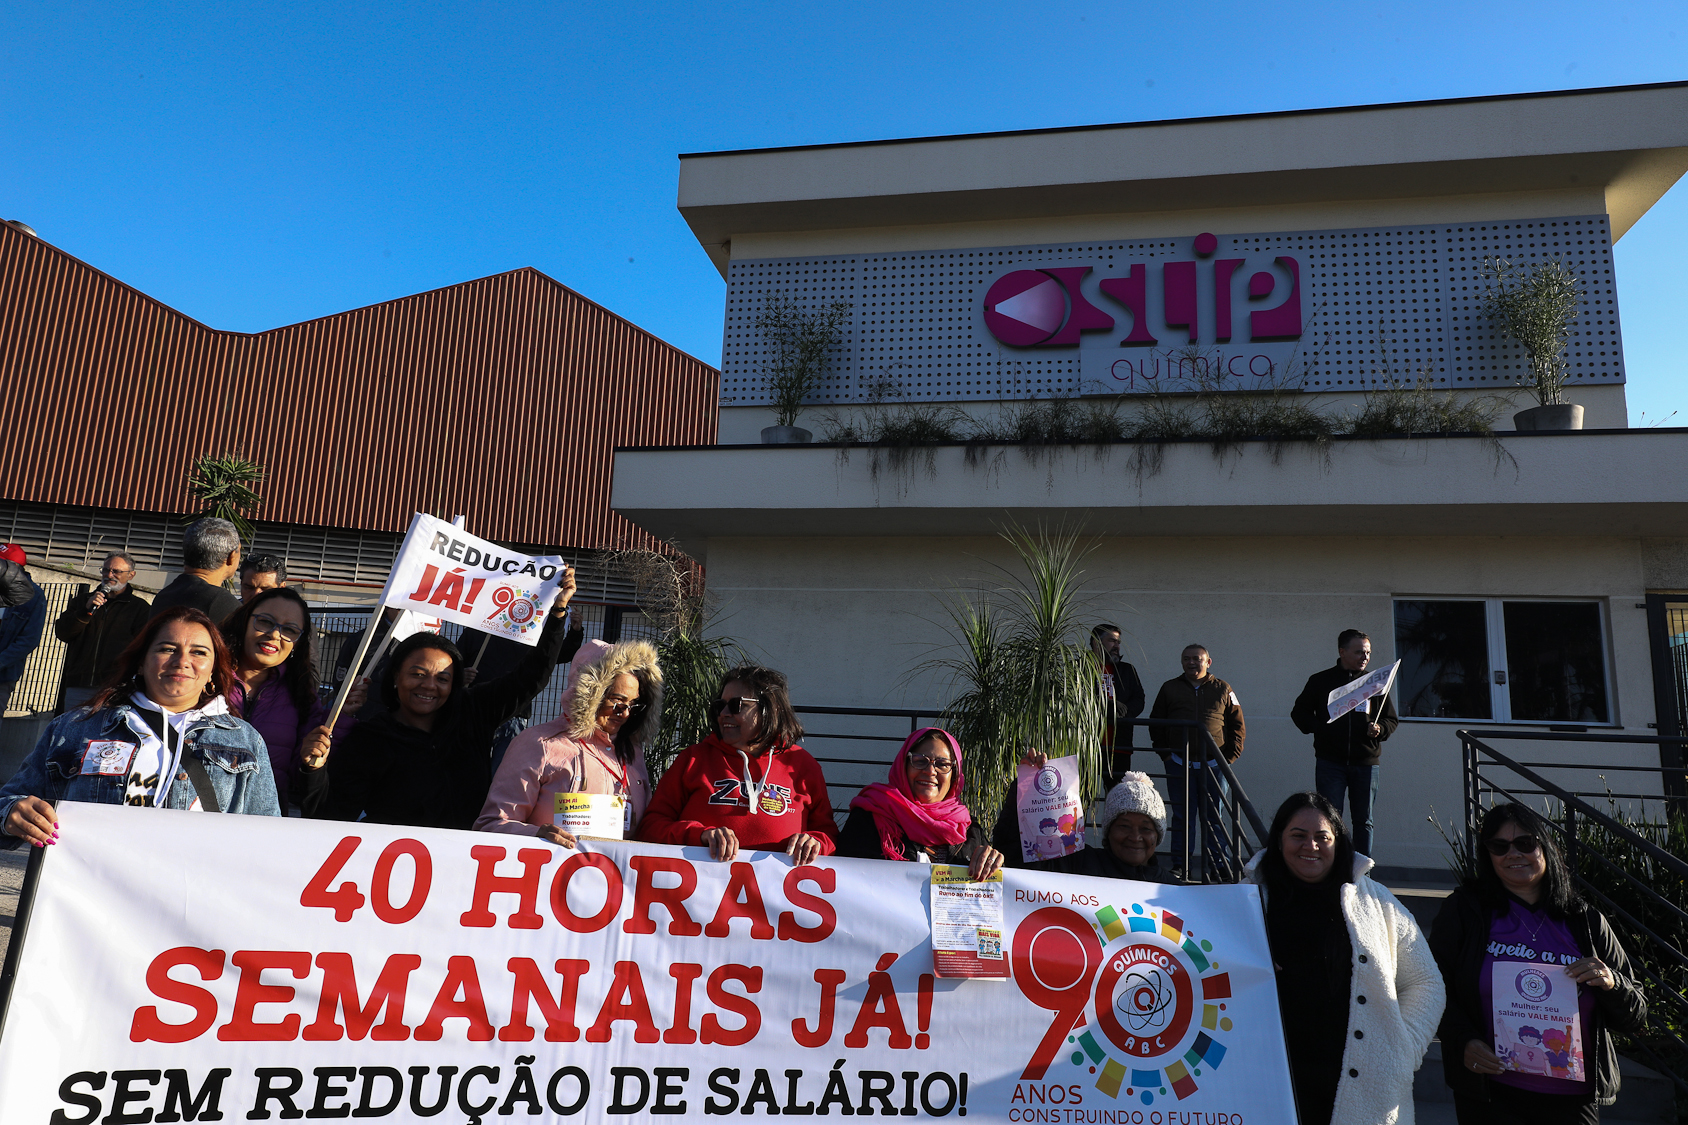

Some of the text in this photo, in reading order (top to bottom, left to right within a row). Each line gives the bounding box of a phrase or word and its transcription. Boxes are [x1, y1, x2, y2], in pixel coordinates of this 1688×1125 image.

[1111, 350, 1274, 389] química
[429, 530, 557, 581] REDUÇÃO
[409, 563, 487, 615] JÁ!
[1021, 806, 1044, 814] salário
[1031, 797, 1057, 806] Mulher:
[300, 836, 838, 944] 40 HORAS
[1014, 889, 1100, 907] RUMO AOS
[1113, 946, 1178, 976] QUÍMICOS
[129, 946, 935, 1050] SEMANAIS JÁ!
[1511, 1001, 1560, 1013] Mulher: seu
[1498, 1009, 1574, 1024] salário VALE MAIS!
[49, 1055, 969, 1125] SEM REDUÇÃO DE SALÁRIO!
[1011, 1083, 1083, 1105] ANOS
[1008, 1108, 1244, 1125] CONSTRUINDO O FUTURO
